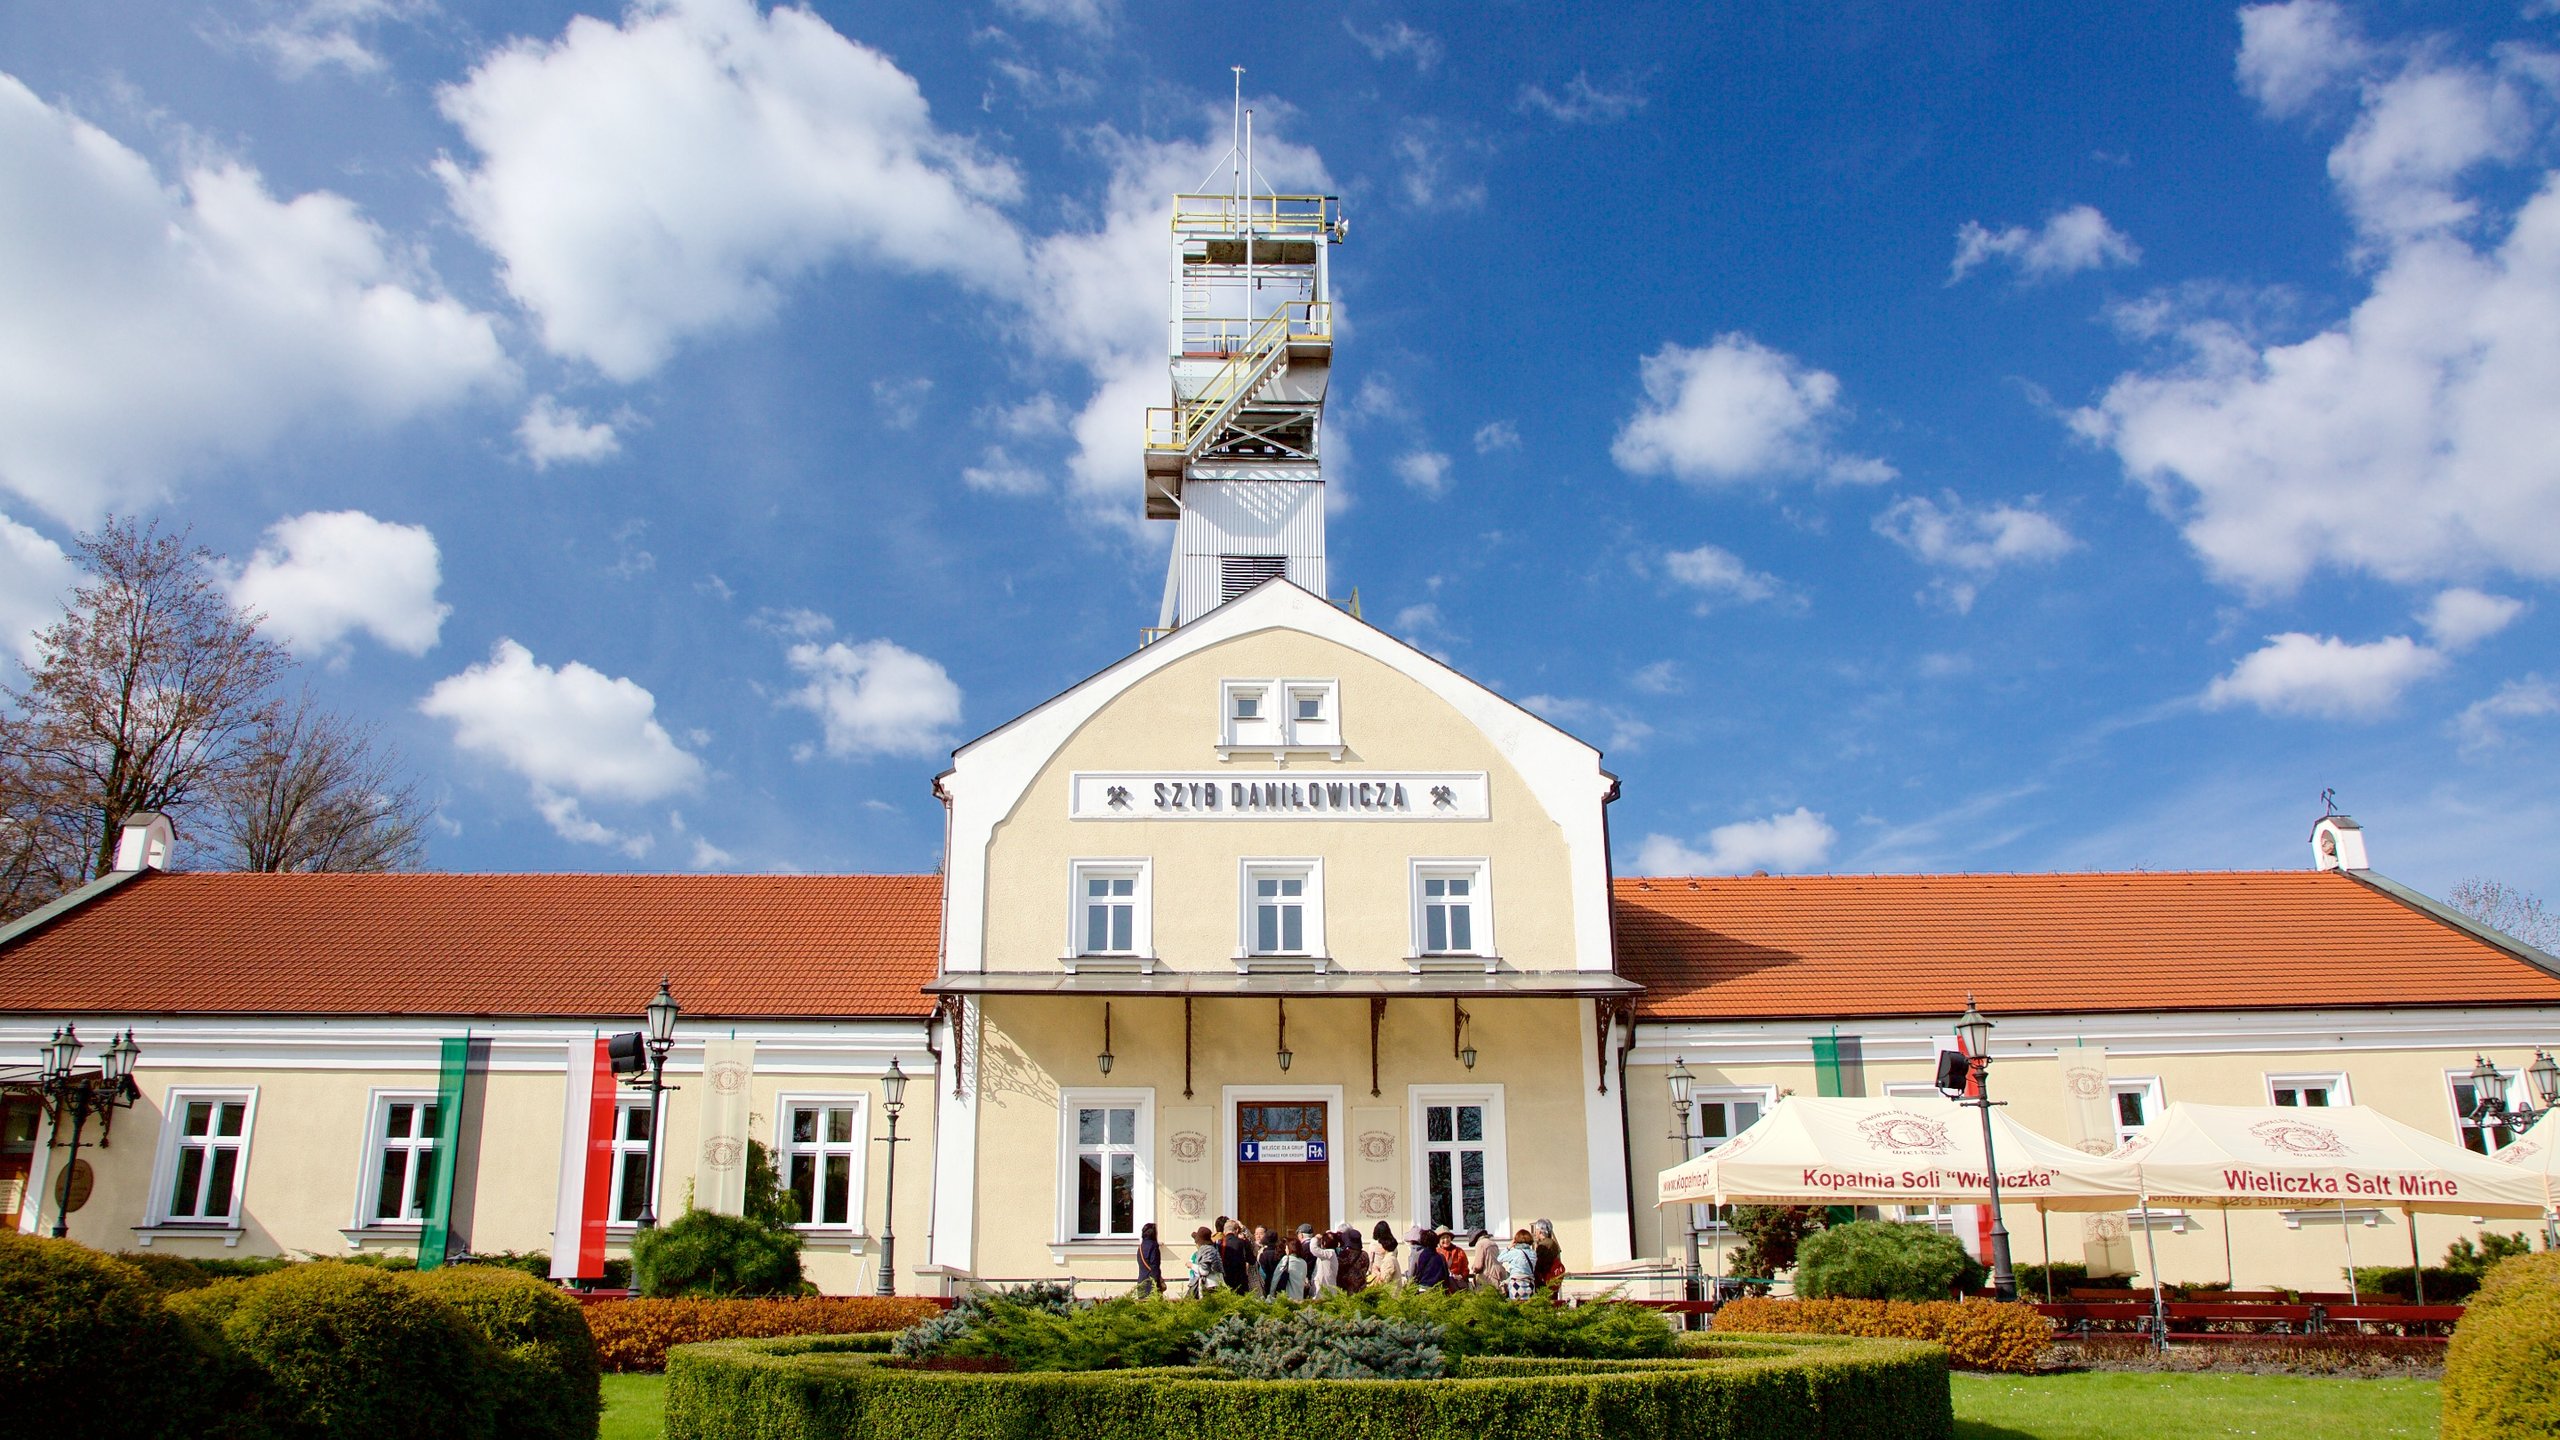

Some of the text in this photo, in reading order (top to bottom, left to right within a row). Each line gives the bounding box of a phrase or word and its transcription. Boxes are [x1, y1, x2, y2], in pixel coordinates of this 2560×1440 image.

[1153, 782, 1405, 807] SZYB DANIŁOWICZA
[1803, 1169, 2060, 1191] Kopalnia Soli “Wieiczka”
[2223, 1170, 2459, 1196] Wieliczka Salt Mine
